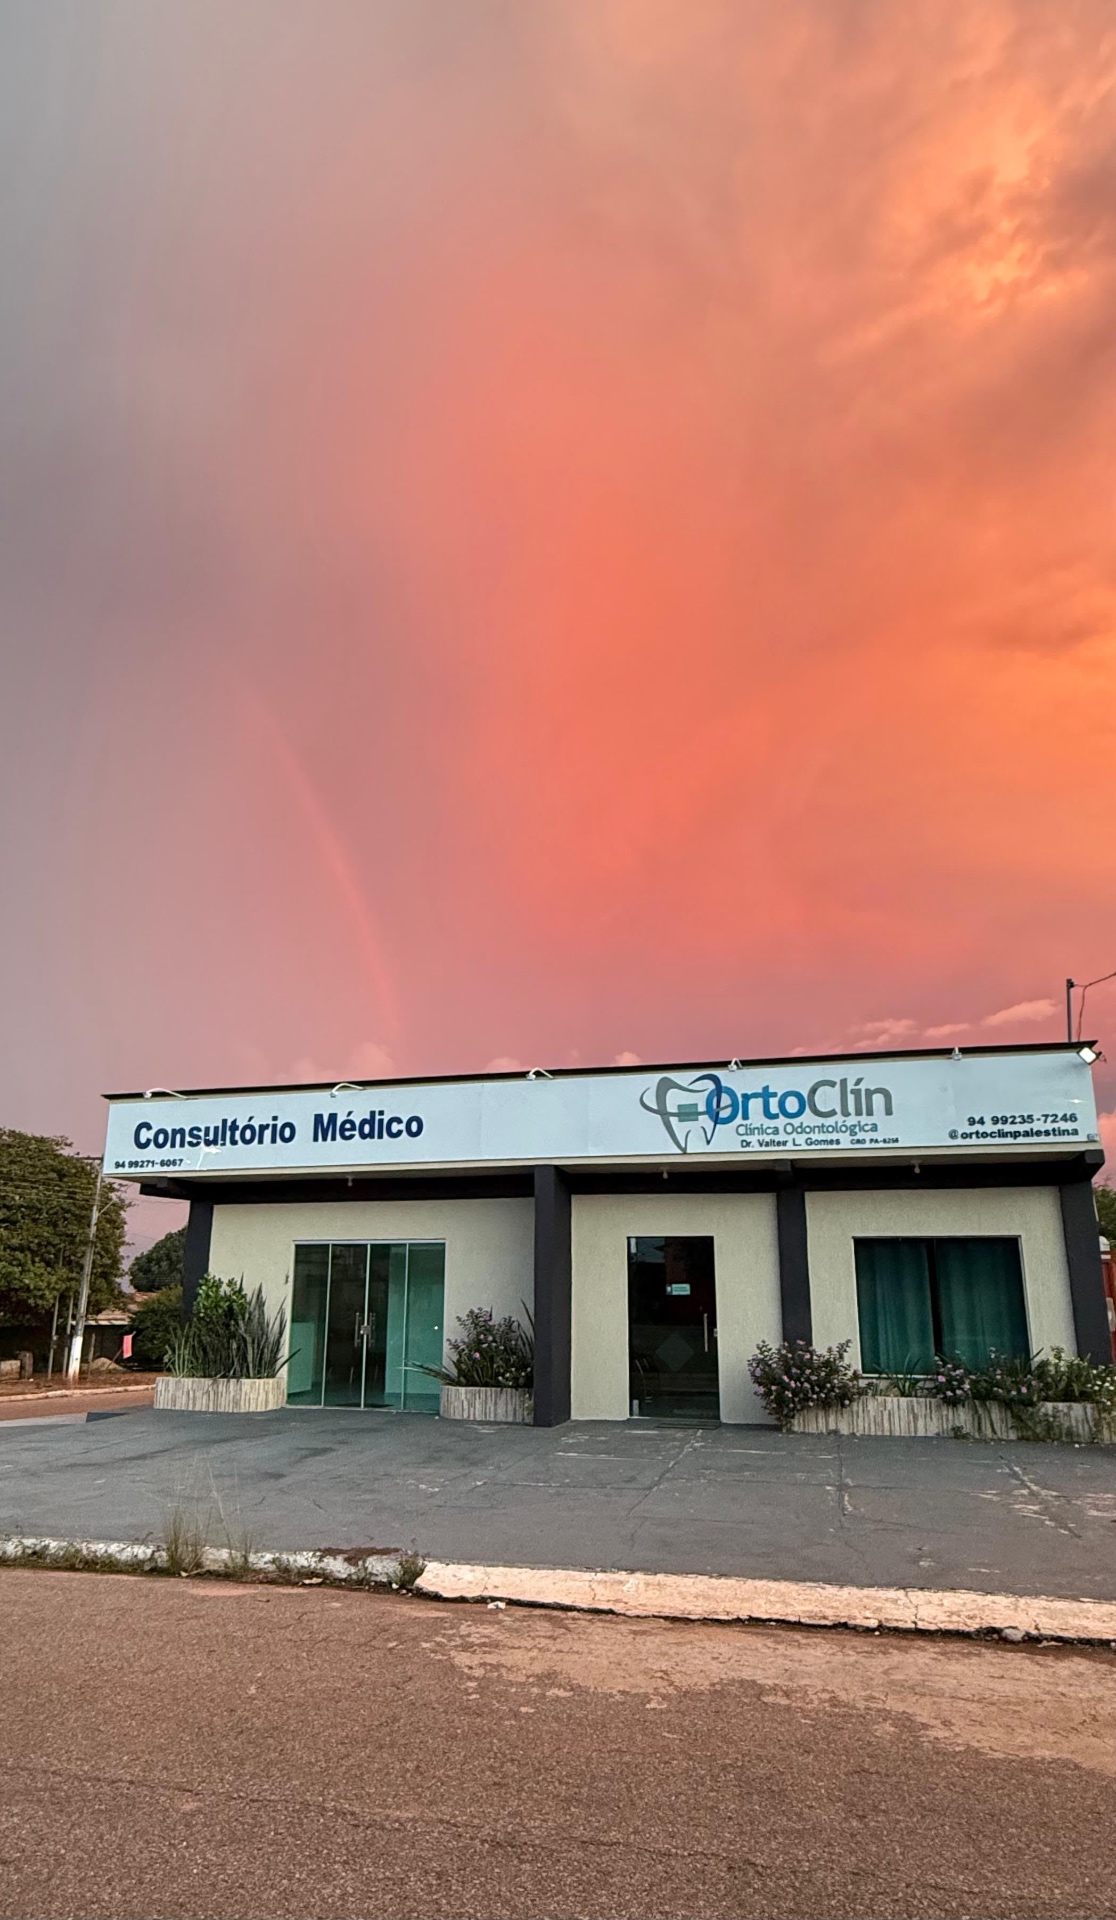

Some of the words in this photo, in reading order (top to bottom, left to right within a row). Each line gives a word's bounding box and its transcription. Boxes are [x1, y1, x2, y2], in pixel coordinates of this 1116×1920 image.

[706, 1077, 893, 1125] OrtoClín
[967, 1116, 986, 1126] 94
[991, 1113, 1078, 1126] 99235-7246
[133, 1115, 296, 1150] Consultório
[312, 1110, 424, 1143] Médico
[736, 1121, 780, 1137] Clínica
[784, 1120, 878, 1139] Odontológica
[948, 1127, 1079, 1140] @ortoclinpalestina
[740, 1139, 754, 1149] Dr.
[805, 1137, 841, 1146] Gomes
[114, 1160, 126, 1169] 94
[127, 1158, 184, 1169] 99271-6067
